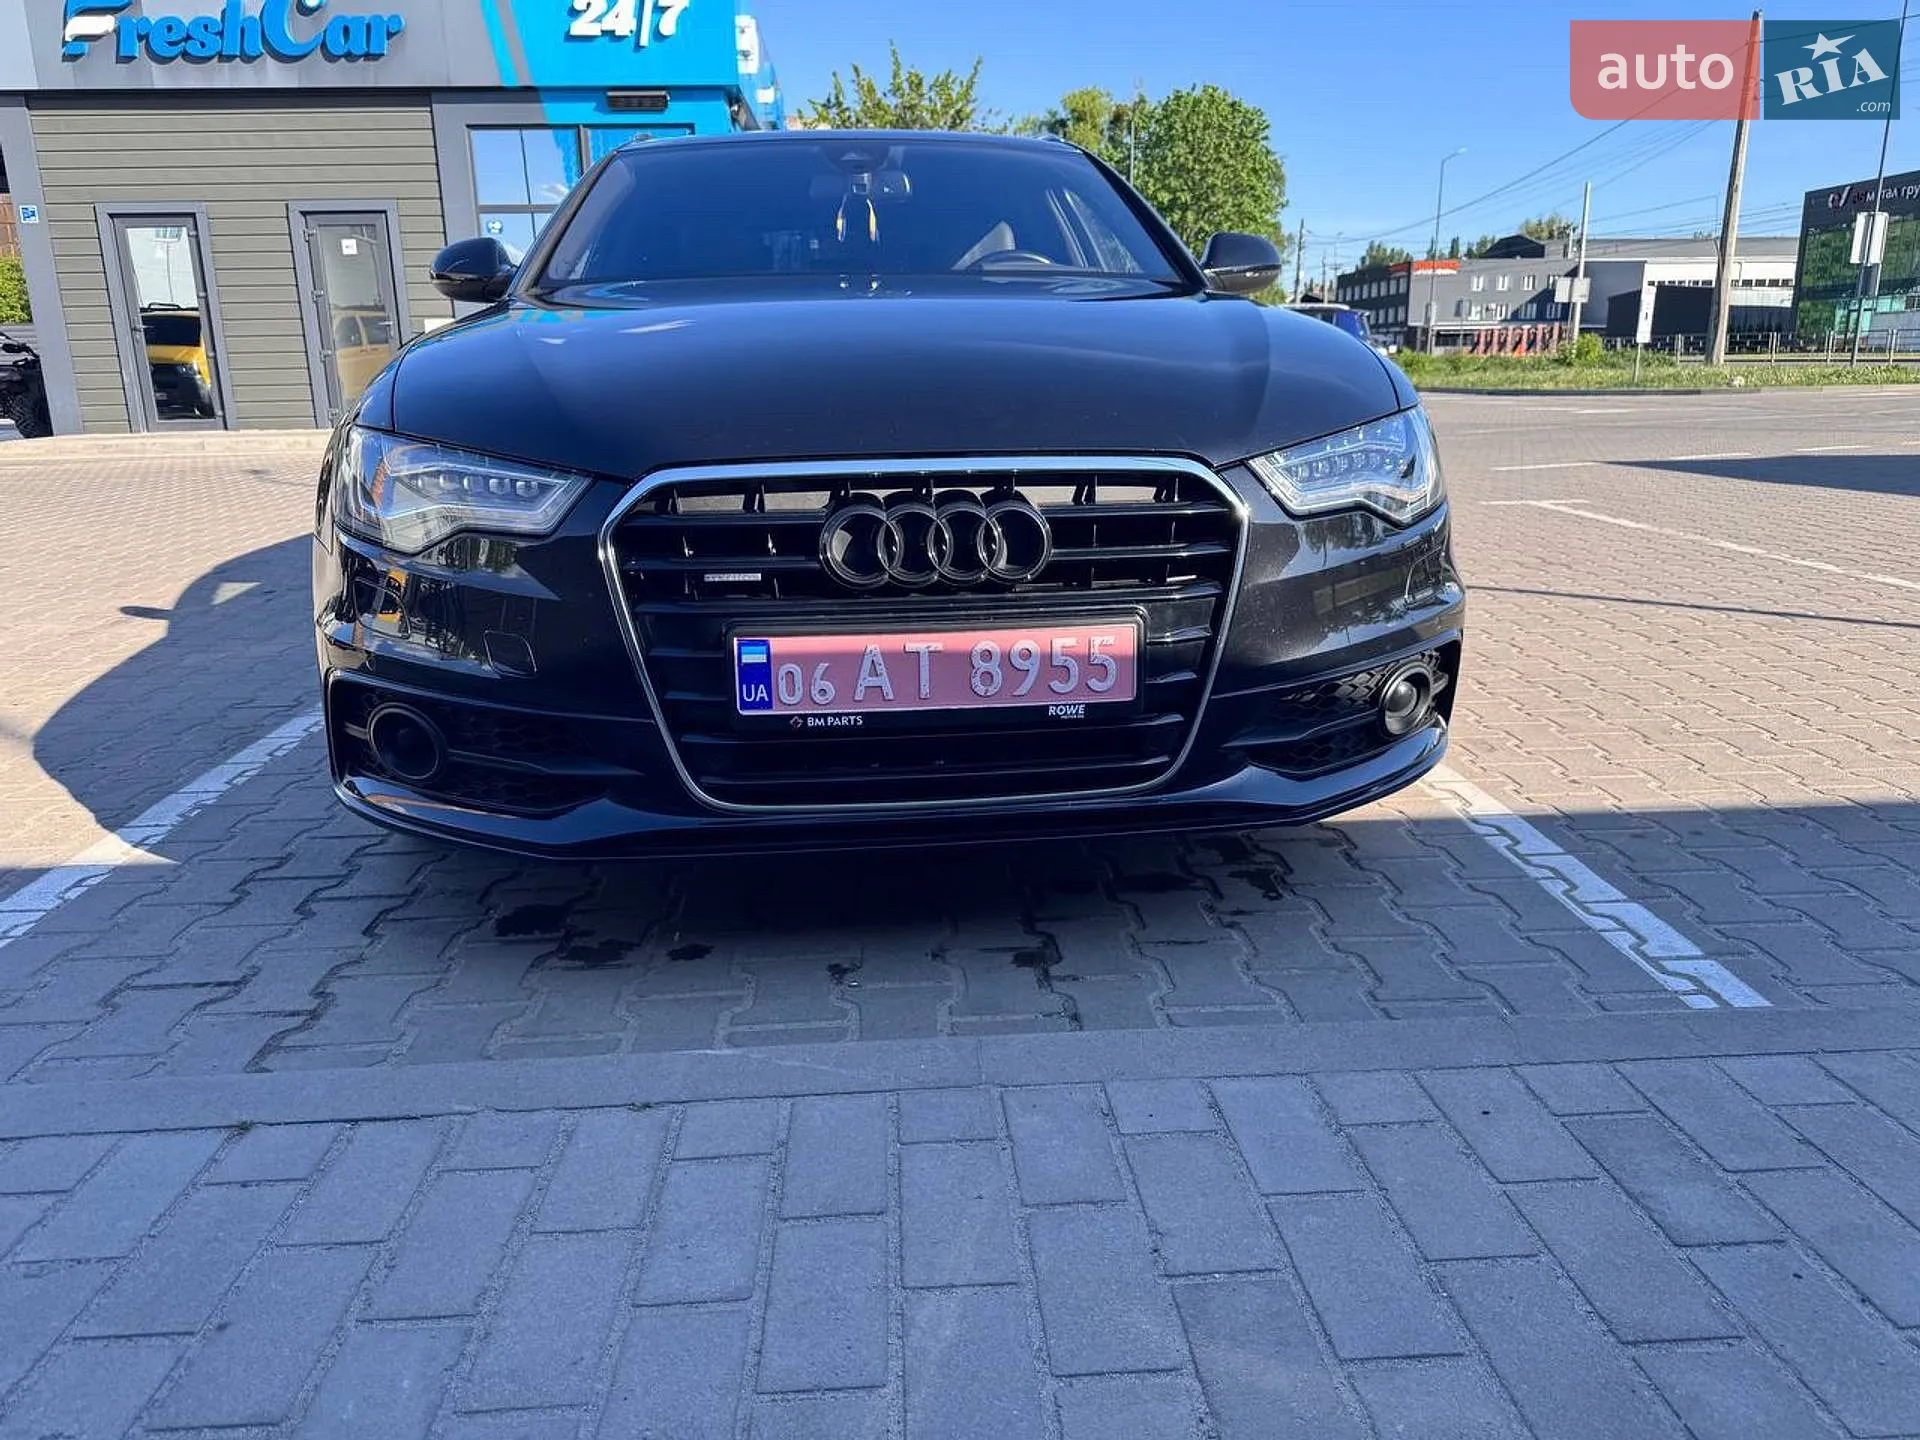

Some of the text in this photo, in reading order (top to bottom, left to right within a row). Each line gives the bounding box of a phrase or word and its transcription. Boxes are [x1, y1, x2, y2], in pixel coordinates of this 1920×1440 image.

[63, 0, 405, 58] FreshCar
[778, 635, 1118, 705] 06 AT 8955
[743, 684, 769, 701] UA
[1048, 703, 1086, 716] ROWE
[807, 715, 863, 727] BM PARTS
